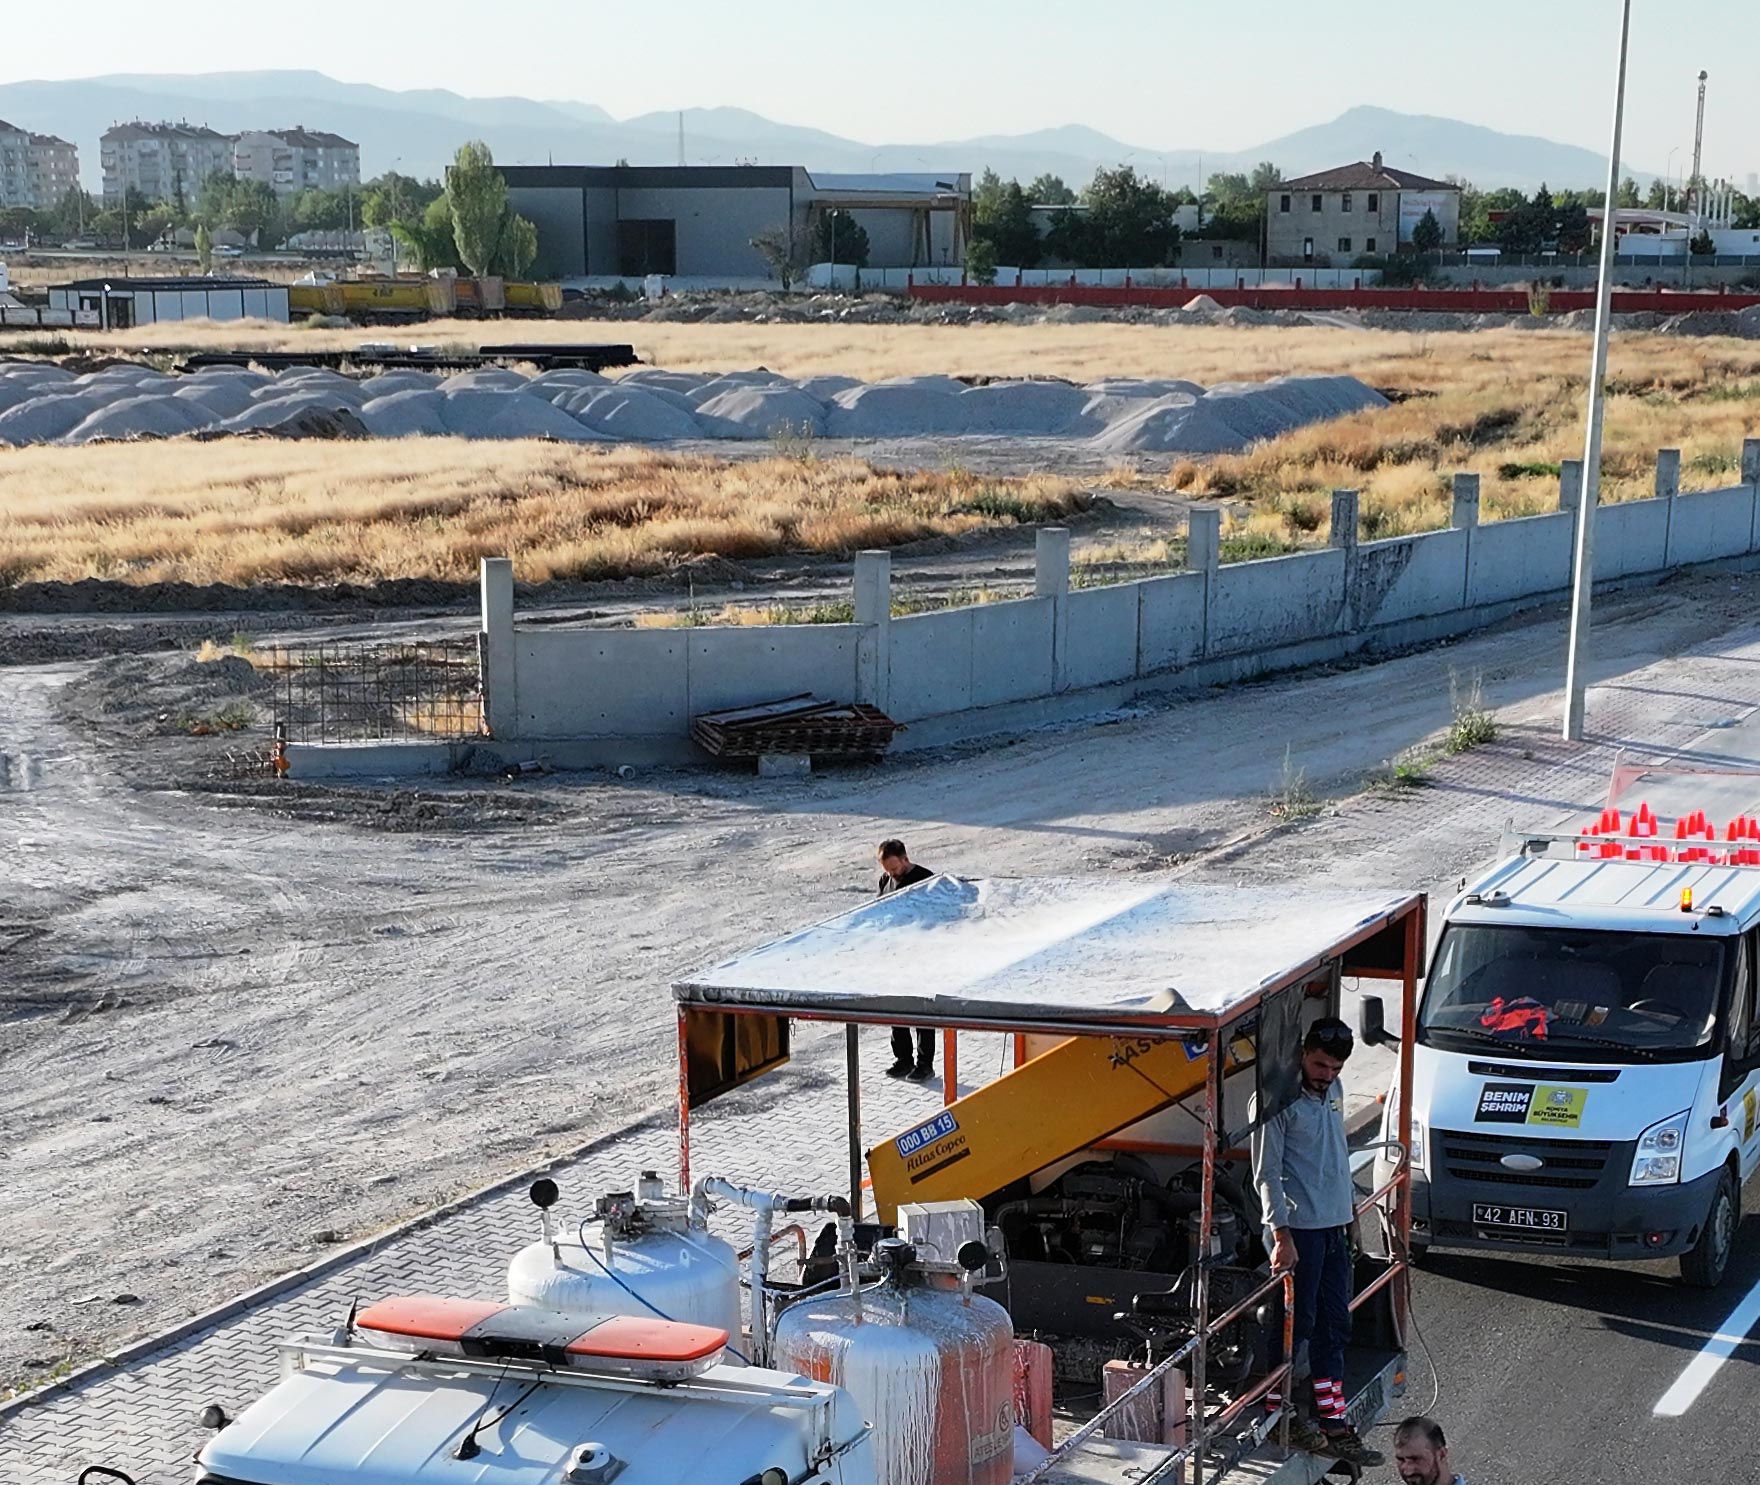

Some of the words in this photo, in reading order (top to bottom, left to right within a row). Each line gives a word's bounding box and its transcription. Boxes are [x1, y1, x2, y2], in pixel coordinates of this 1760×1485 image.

[1483, 1091, 1530, 1103] BENİM
[900, 1132, 921, 1153] 000
[920, 1123, 938, 1141] BB
[937, 1115, 952, 1131] 15
[906, 1150, 936, 1172] Atlas
[935, 1135, 966, 1156] Copco
[1484, 1207, 1501, 1222] 42
[1509, 1209, 1534, 1225] AFN
[1542, 1213, 1559, 1228] 93
